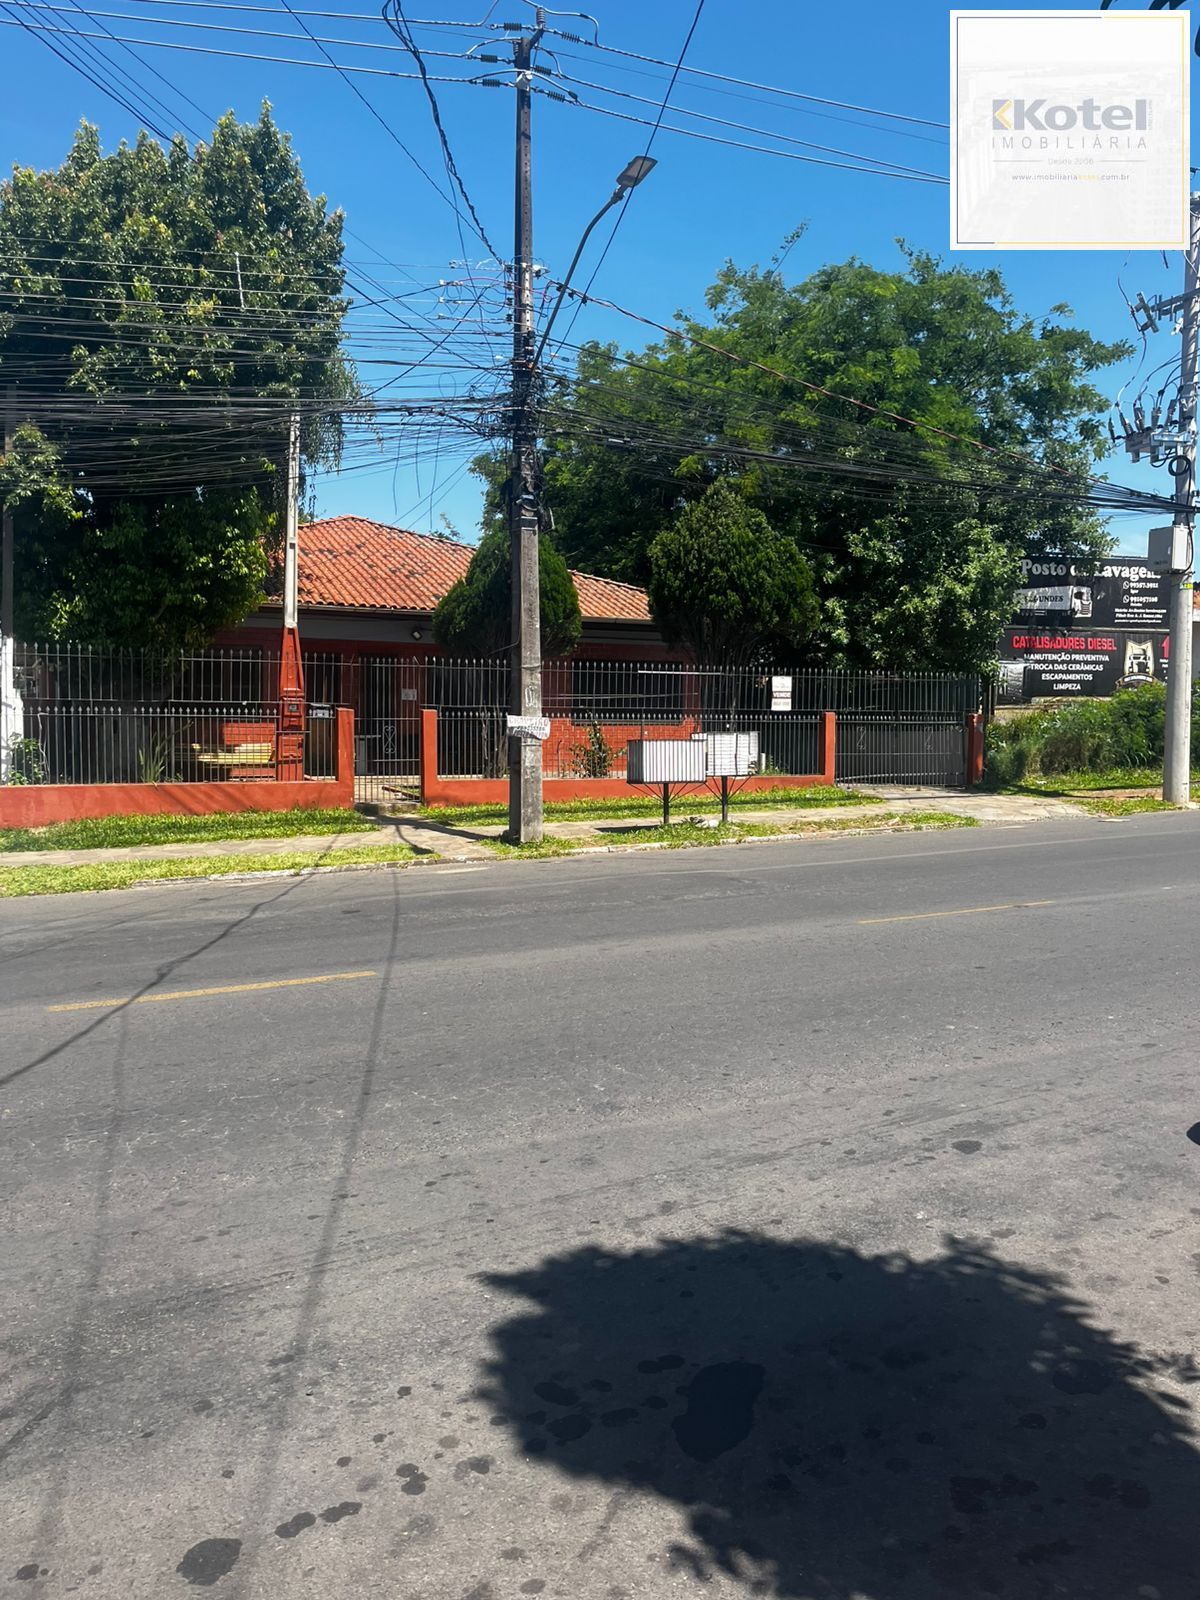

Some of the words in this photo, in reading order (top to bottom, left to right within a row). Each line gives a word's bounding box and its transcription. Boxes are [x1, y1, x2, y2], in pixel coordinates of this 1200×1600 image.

[1020, 559, 1066, 576] Posto
[1088, 638, 1117, 650] DIESEL
[1024, 652, 1070, 662] MANUTENÇÃO
[1030, 663, 1053, 671] TROCA
[1068, 662, 1103, 671] CERÂMICAS
[1042, 673, 1093, 681] ESCAPAMENTOS
